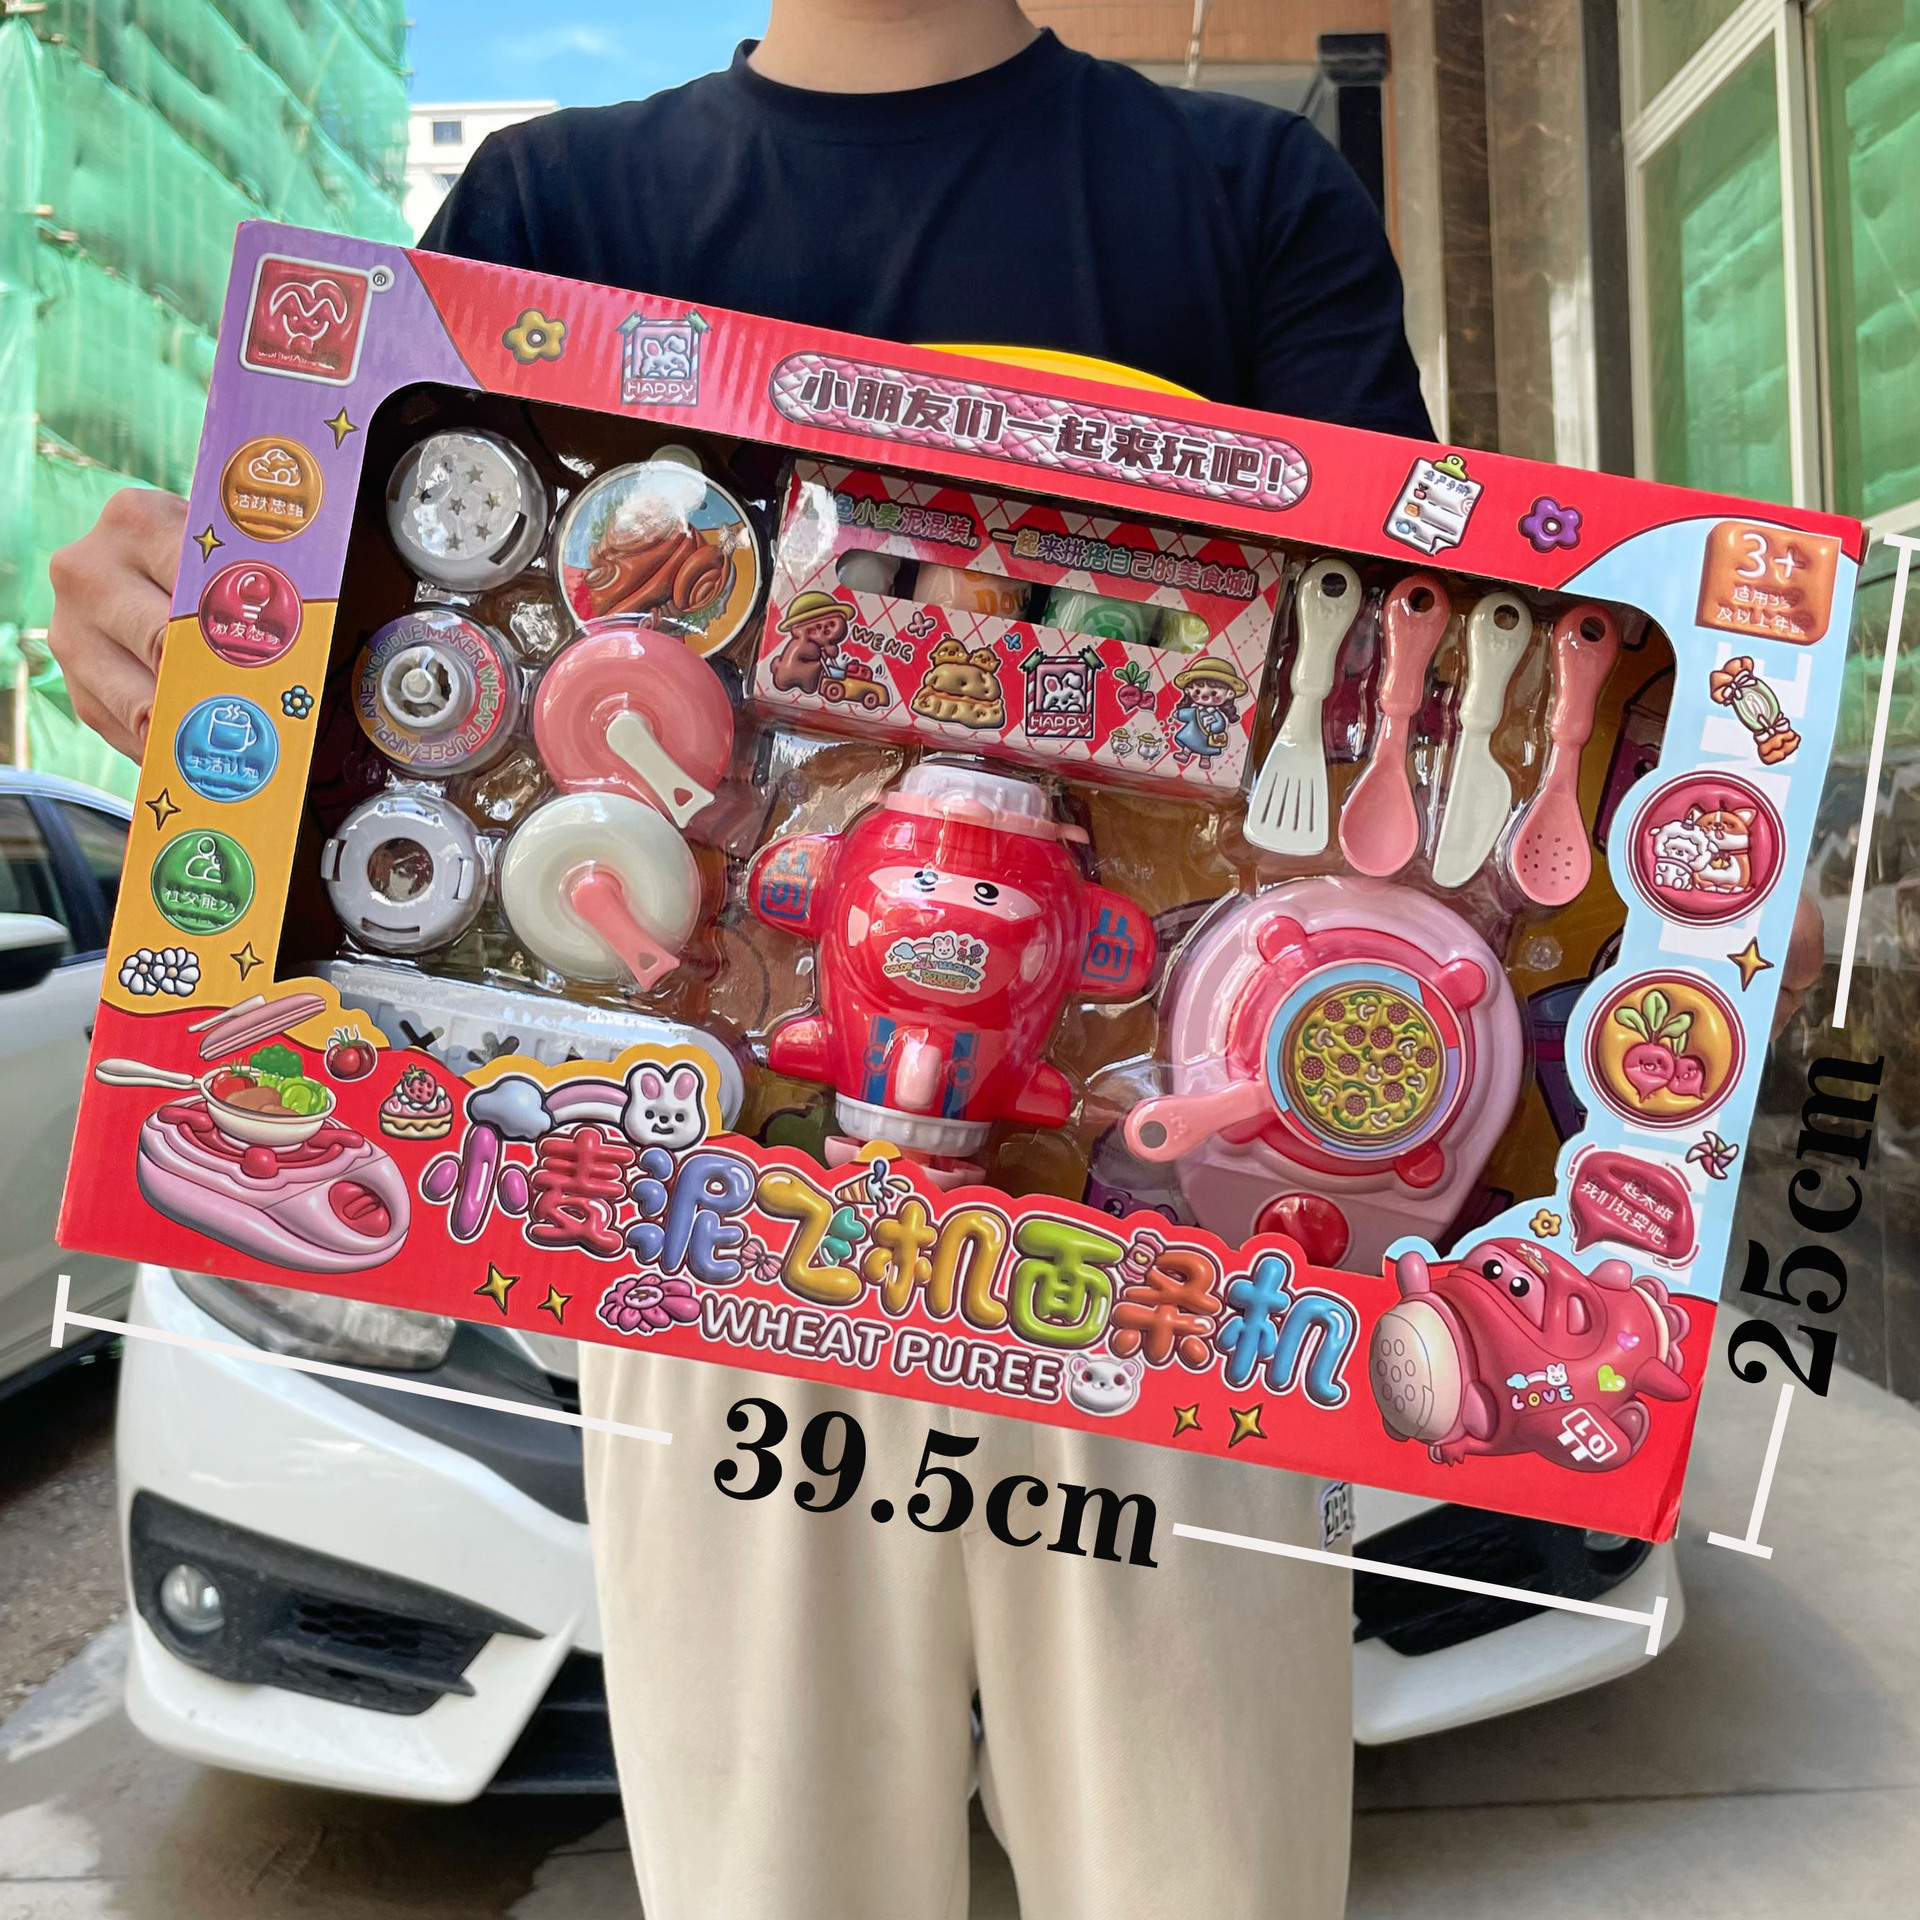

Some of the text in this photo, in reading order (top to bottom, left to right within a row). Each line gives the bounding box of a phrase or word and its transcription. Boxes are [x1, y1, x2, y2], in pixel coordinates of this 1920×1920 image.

[626, 382, 694, 399] HAPPY
[800, 368, 1284, 493] 小朋友们一起来玩吧！
[1736, 533, 1801, 579] 3+
[360, 624, 499, 761] AIRPLANE NOODLE MAKER WHEAT PUREE
[1030, 713, 1090, 731] HAPPY
[1092, 944, 1121, 969] 01
[424, 1124, 1349, 1406] 小麦泥飞机面条机
[702, 1300, 1062, 1400] WHEAT PUREE
[1510, 1385, 1574, 1411] LOVE
